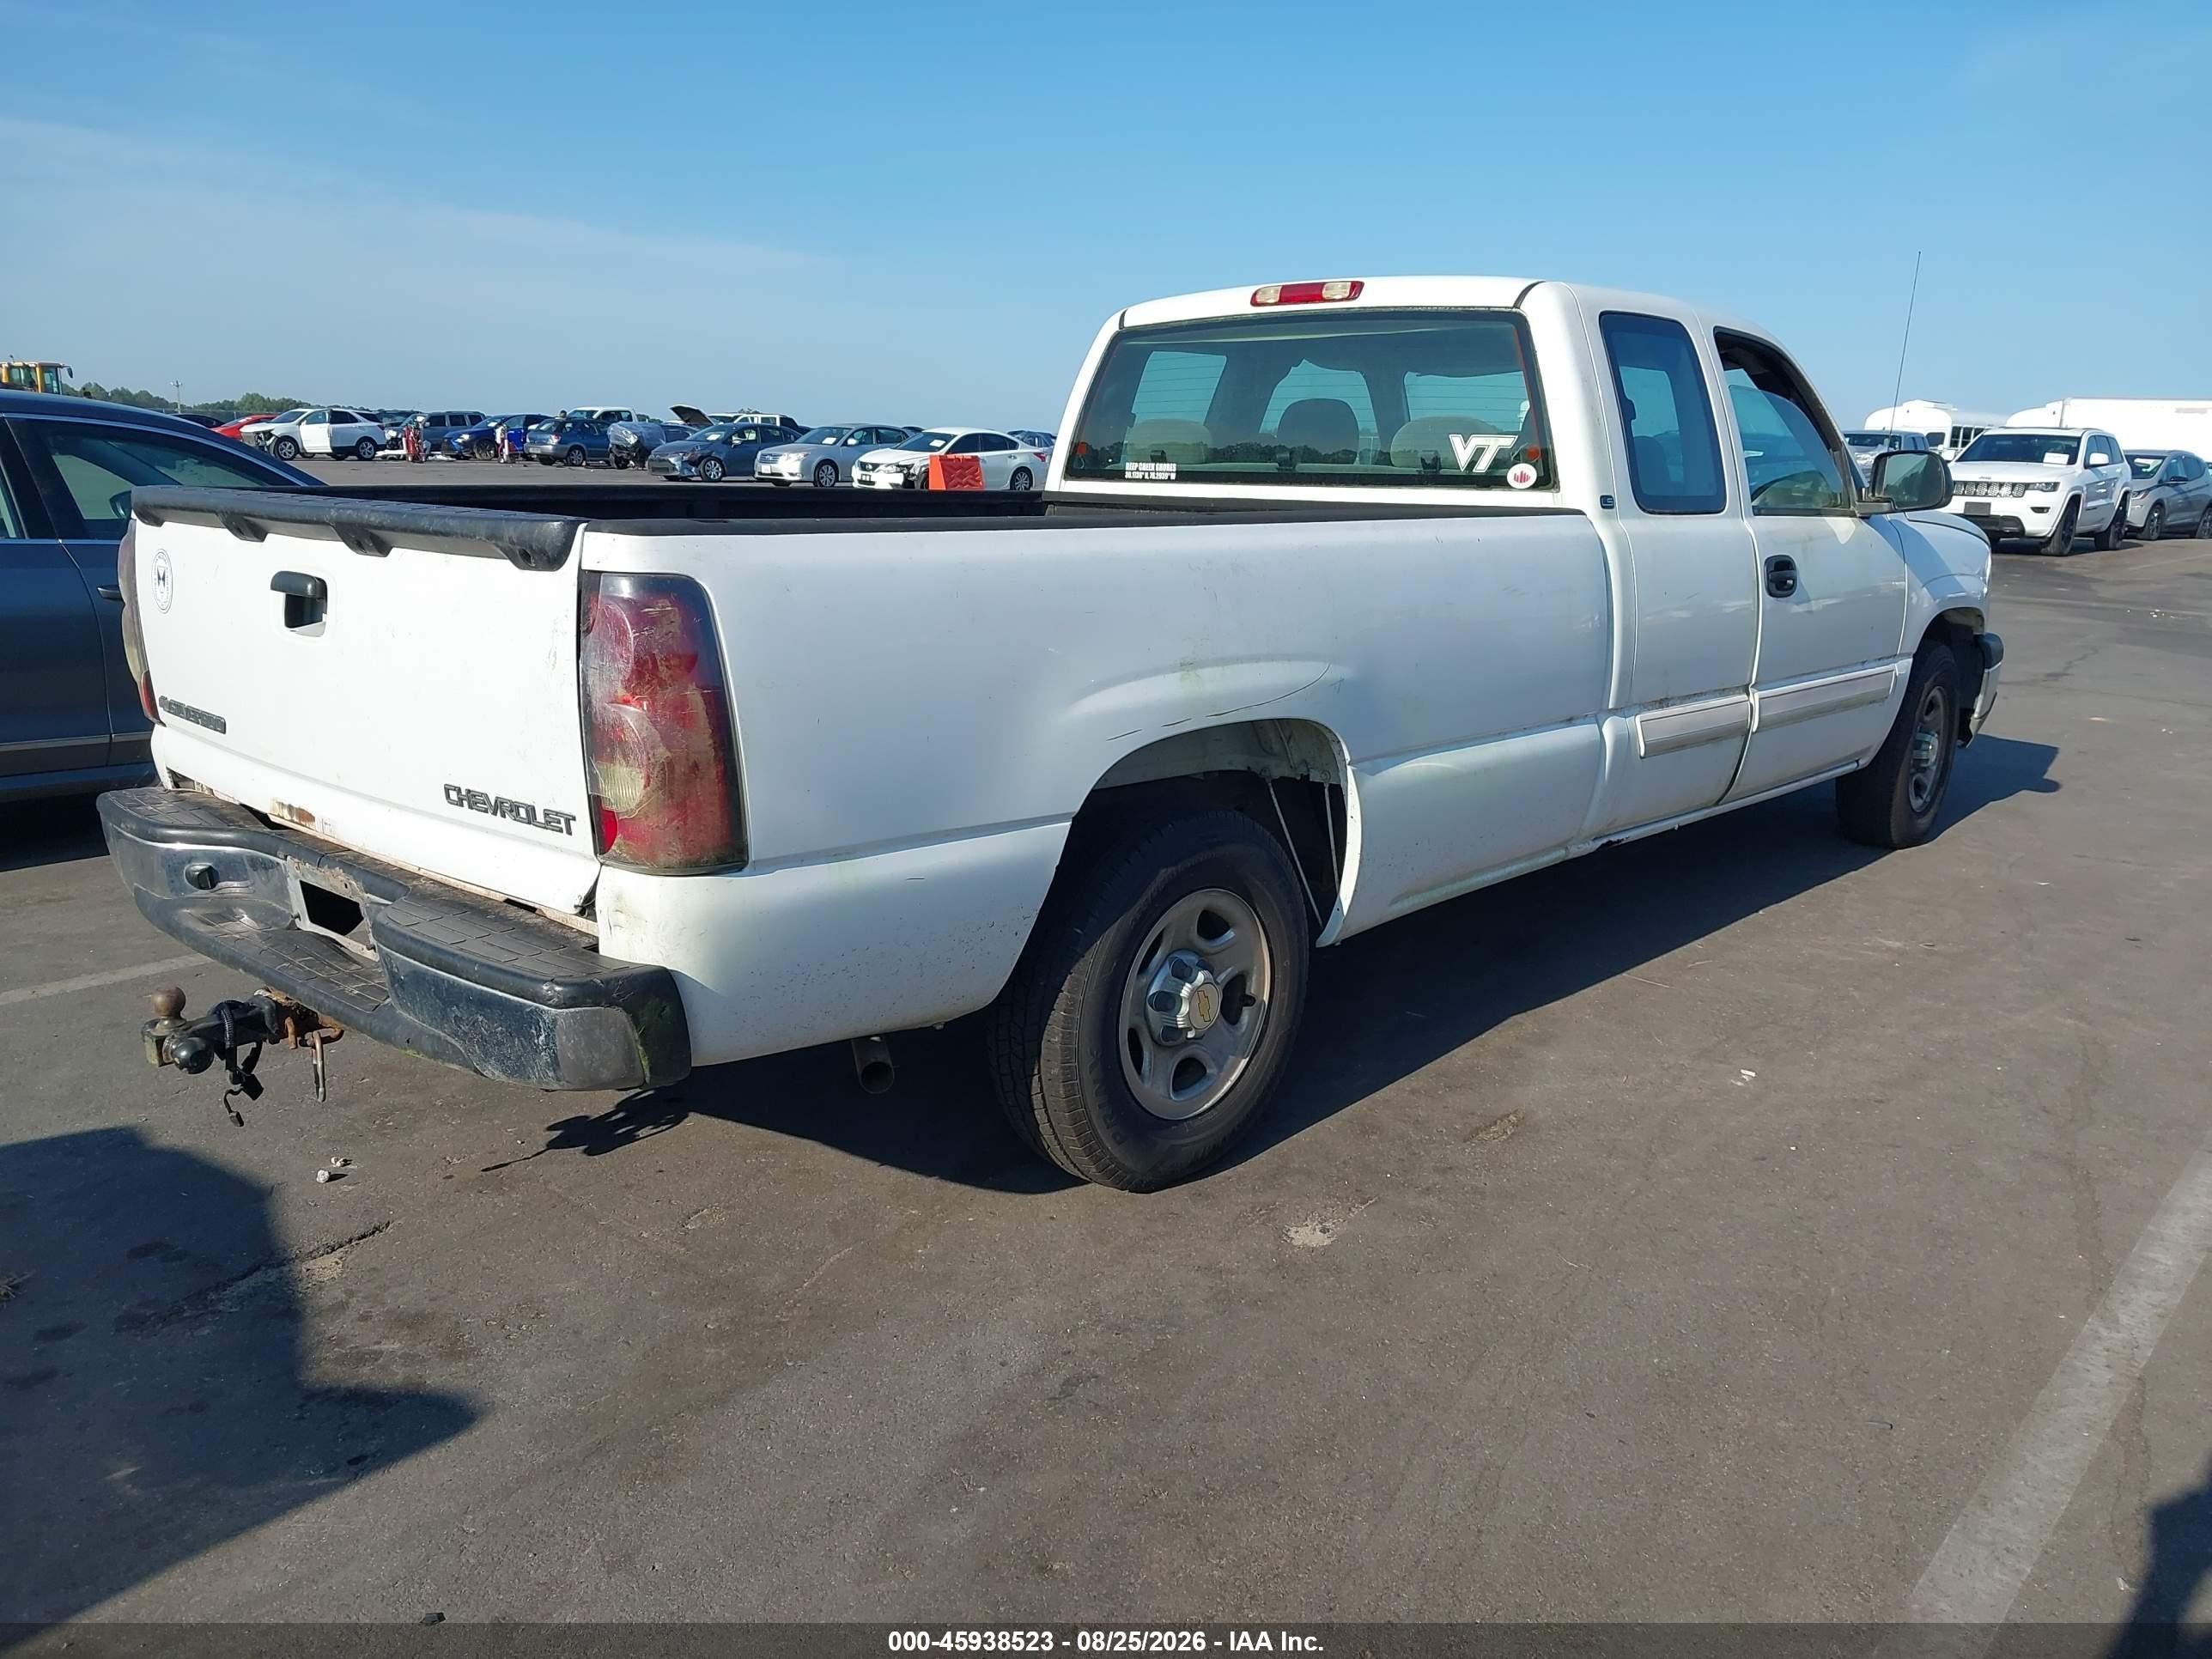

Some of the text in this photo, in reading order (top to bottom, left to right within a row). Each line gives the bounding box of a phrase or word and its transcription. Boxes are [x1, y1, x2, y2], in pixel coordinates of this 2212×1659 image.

[1139, 462, 1155, 471] CREEK
[1156, 463, 1176, 472] SHORES
[1449, 434, 1518, 472] VT
[444, 784, 576, 836] CHEVROLET
